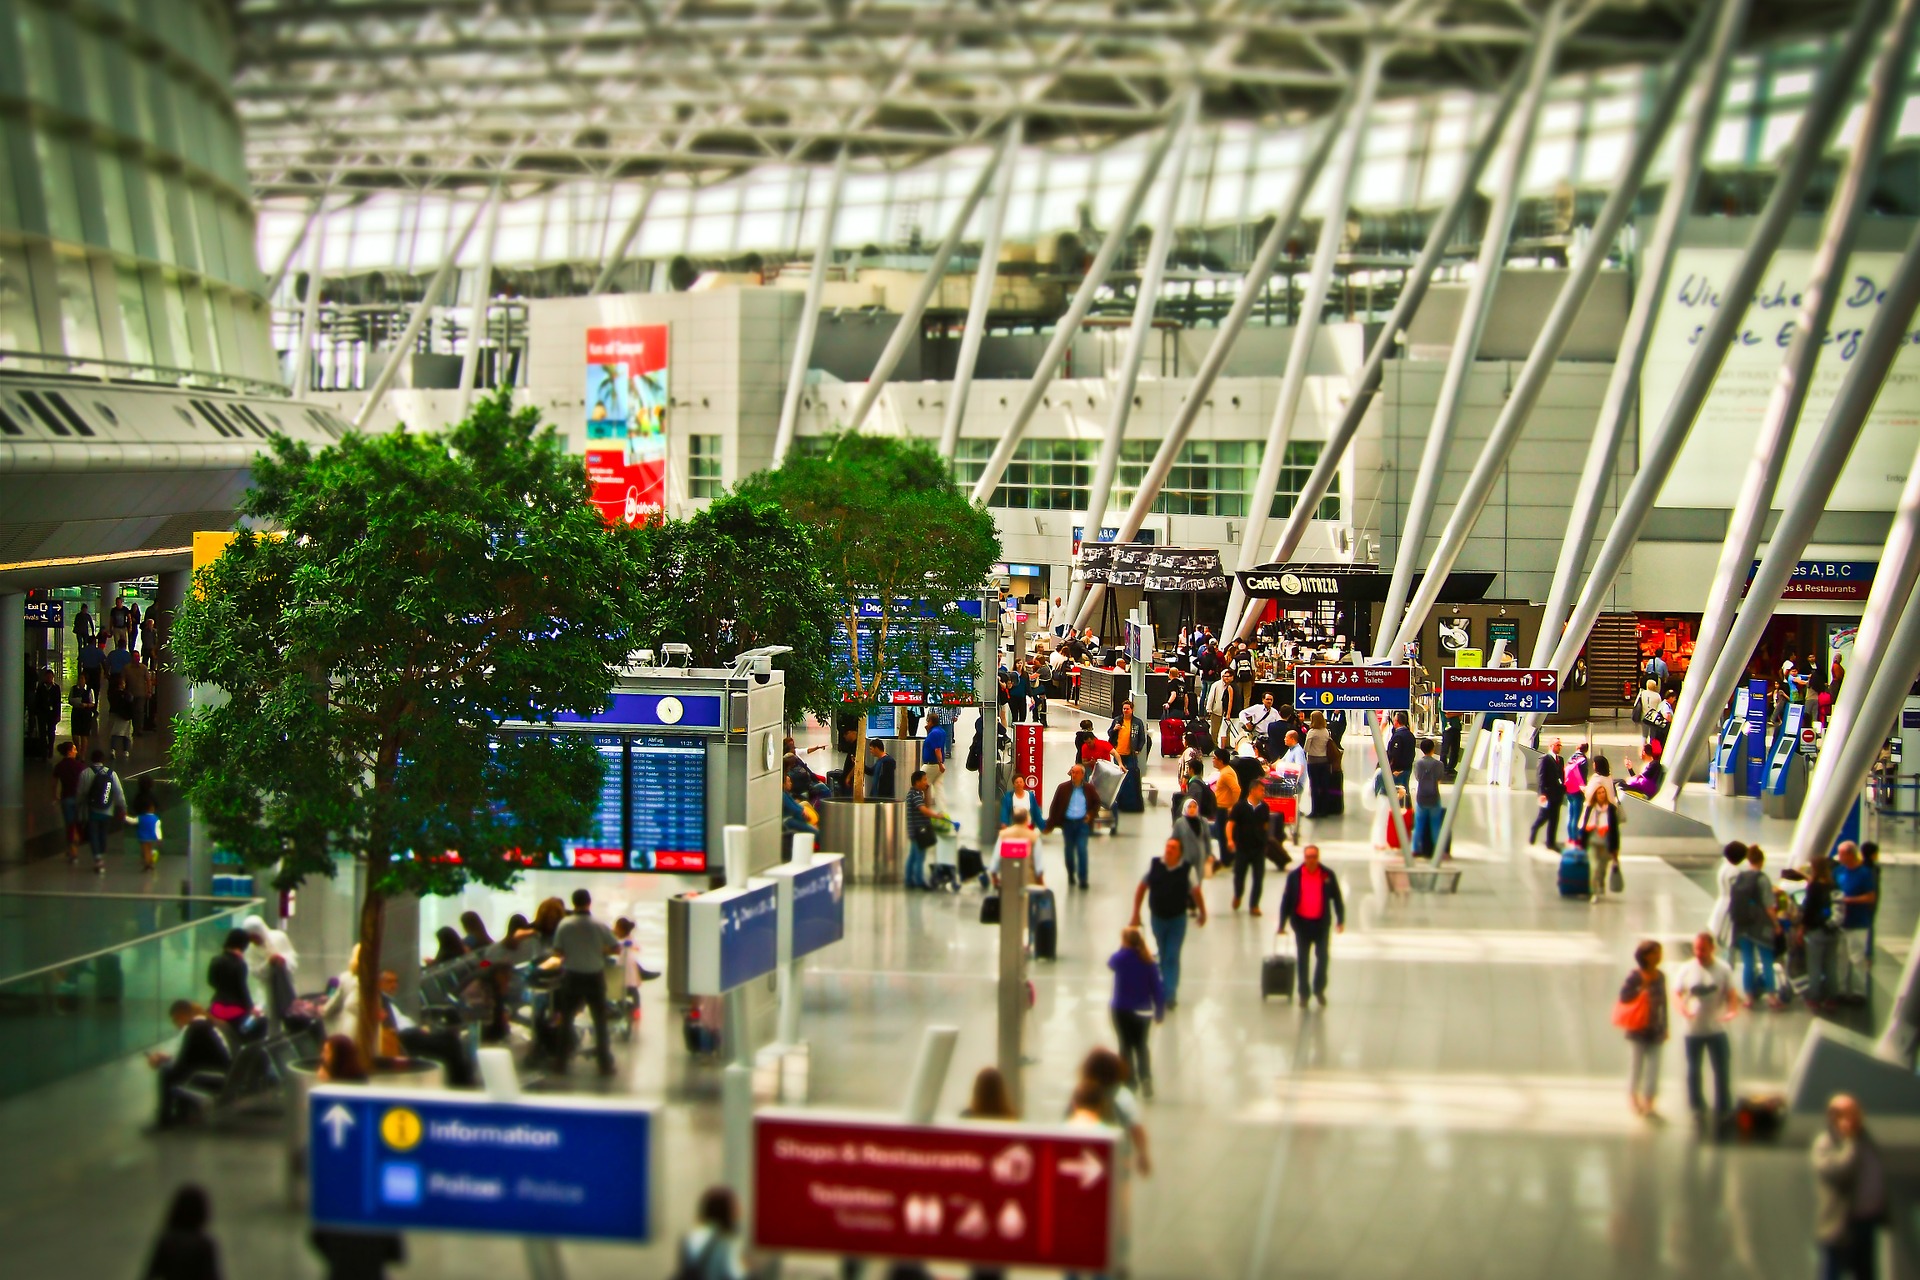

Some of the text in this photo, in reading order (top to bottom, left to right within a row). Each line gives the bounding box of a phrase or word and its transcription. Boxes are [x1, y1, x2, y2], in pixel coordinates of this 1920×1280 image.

[1246, 576, 1281, 590] Caffè
[1804, 584, 1857, 593] Restaurants
[1450, 675, 1471, 683] Shops
[1478, 675, 1518, 683] Restaurants
[1336, 694, 1380, 702] Information
[1488, 700, 1517, 708] Customs
[1028, 726, 1036, 773] SAFER
[429, 1121, 558, 1146] Information
[773, 1138, 838, 1164] Shops
[861, 1144, 985, 1173] Restaurants
